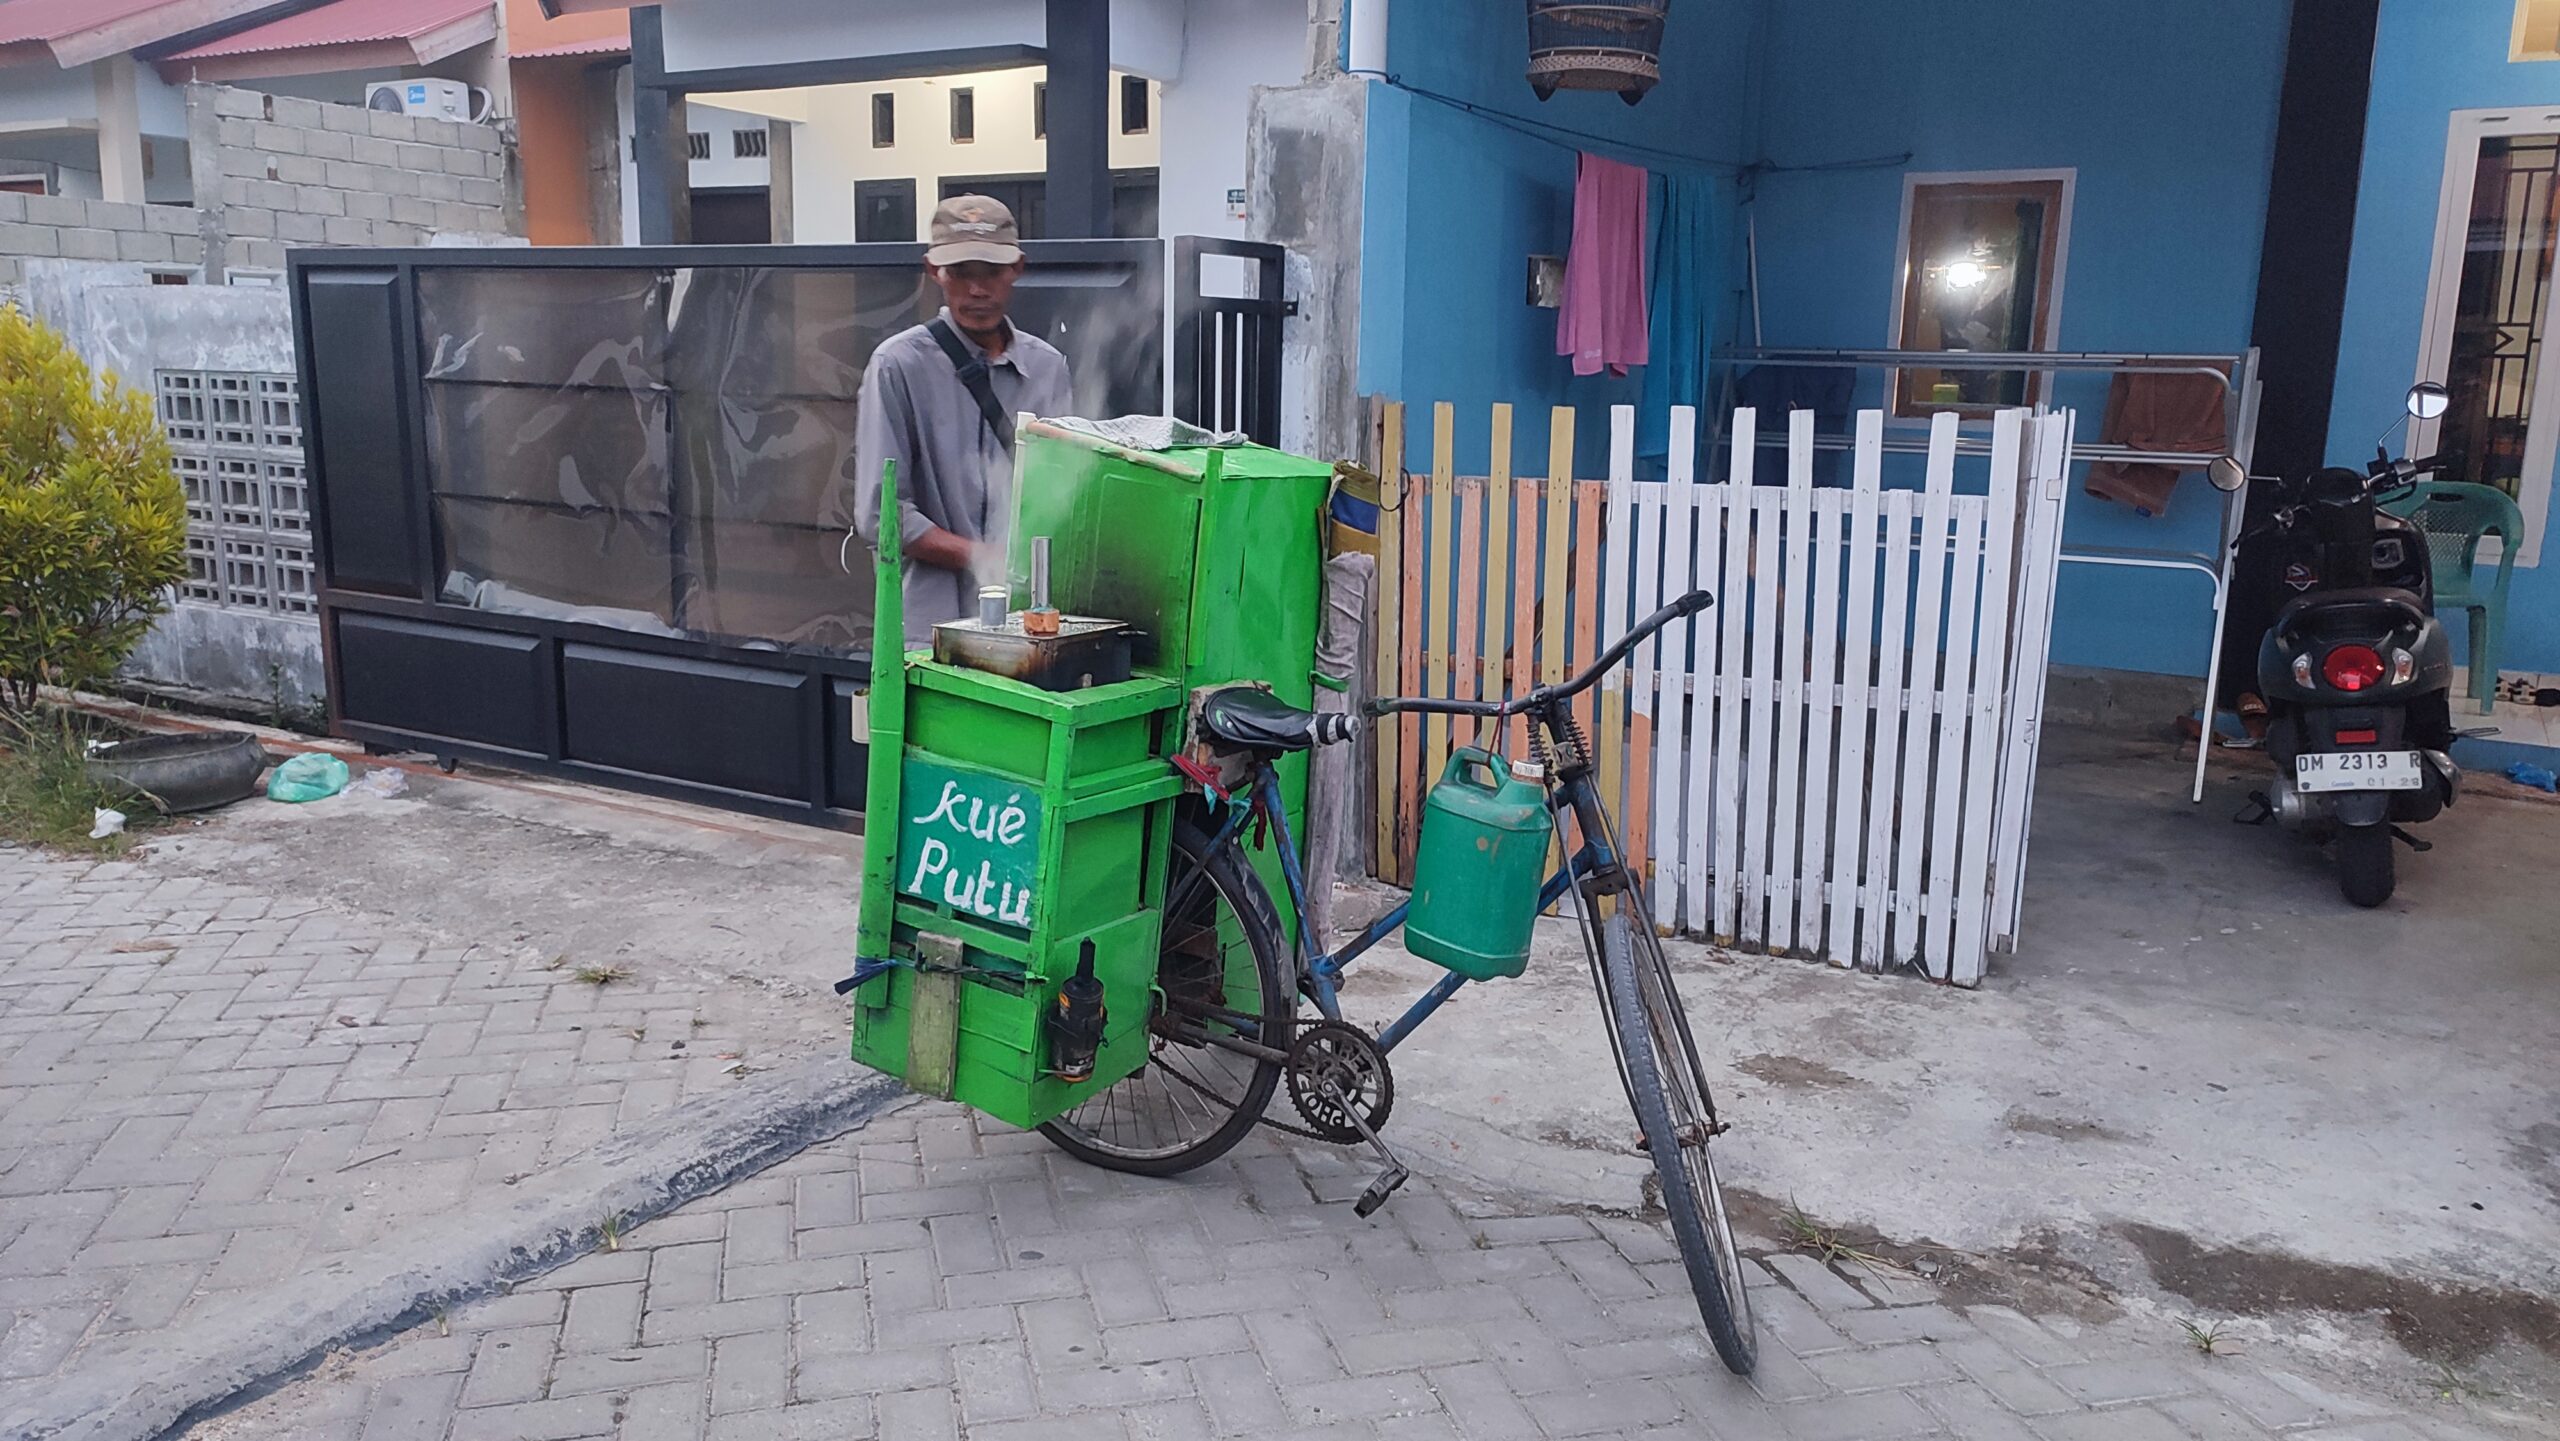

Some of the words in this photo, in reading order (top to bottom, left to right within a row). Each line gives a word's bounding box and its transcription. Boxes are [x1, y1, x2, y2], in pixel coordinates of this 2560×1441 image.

[2298, 755, 2324, 772] DM
[2339, 753, 2388, 770] 2313
[2409, 752, 2421, 768] R
[907, 836, 1031, 927] Putu
